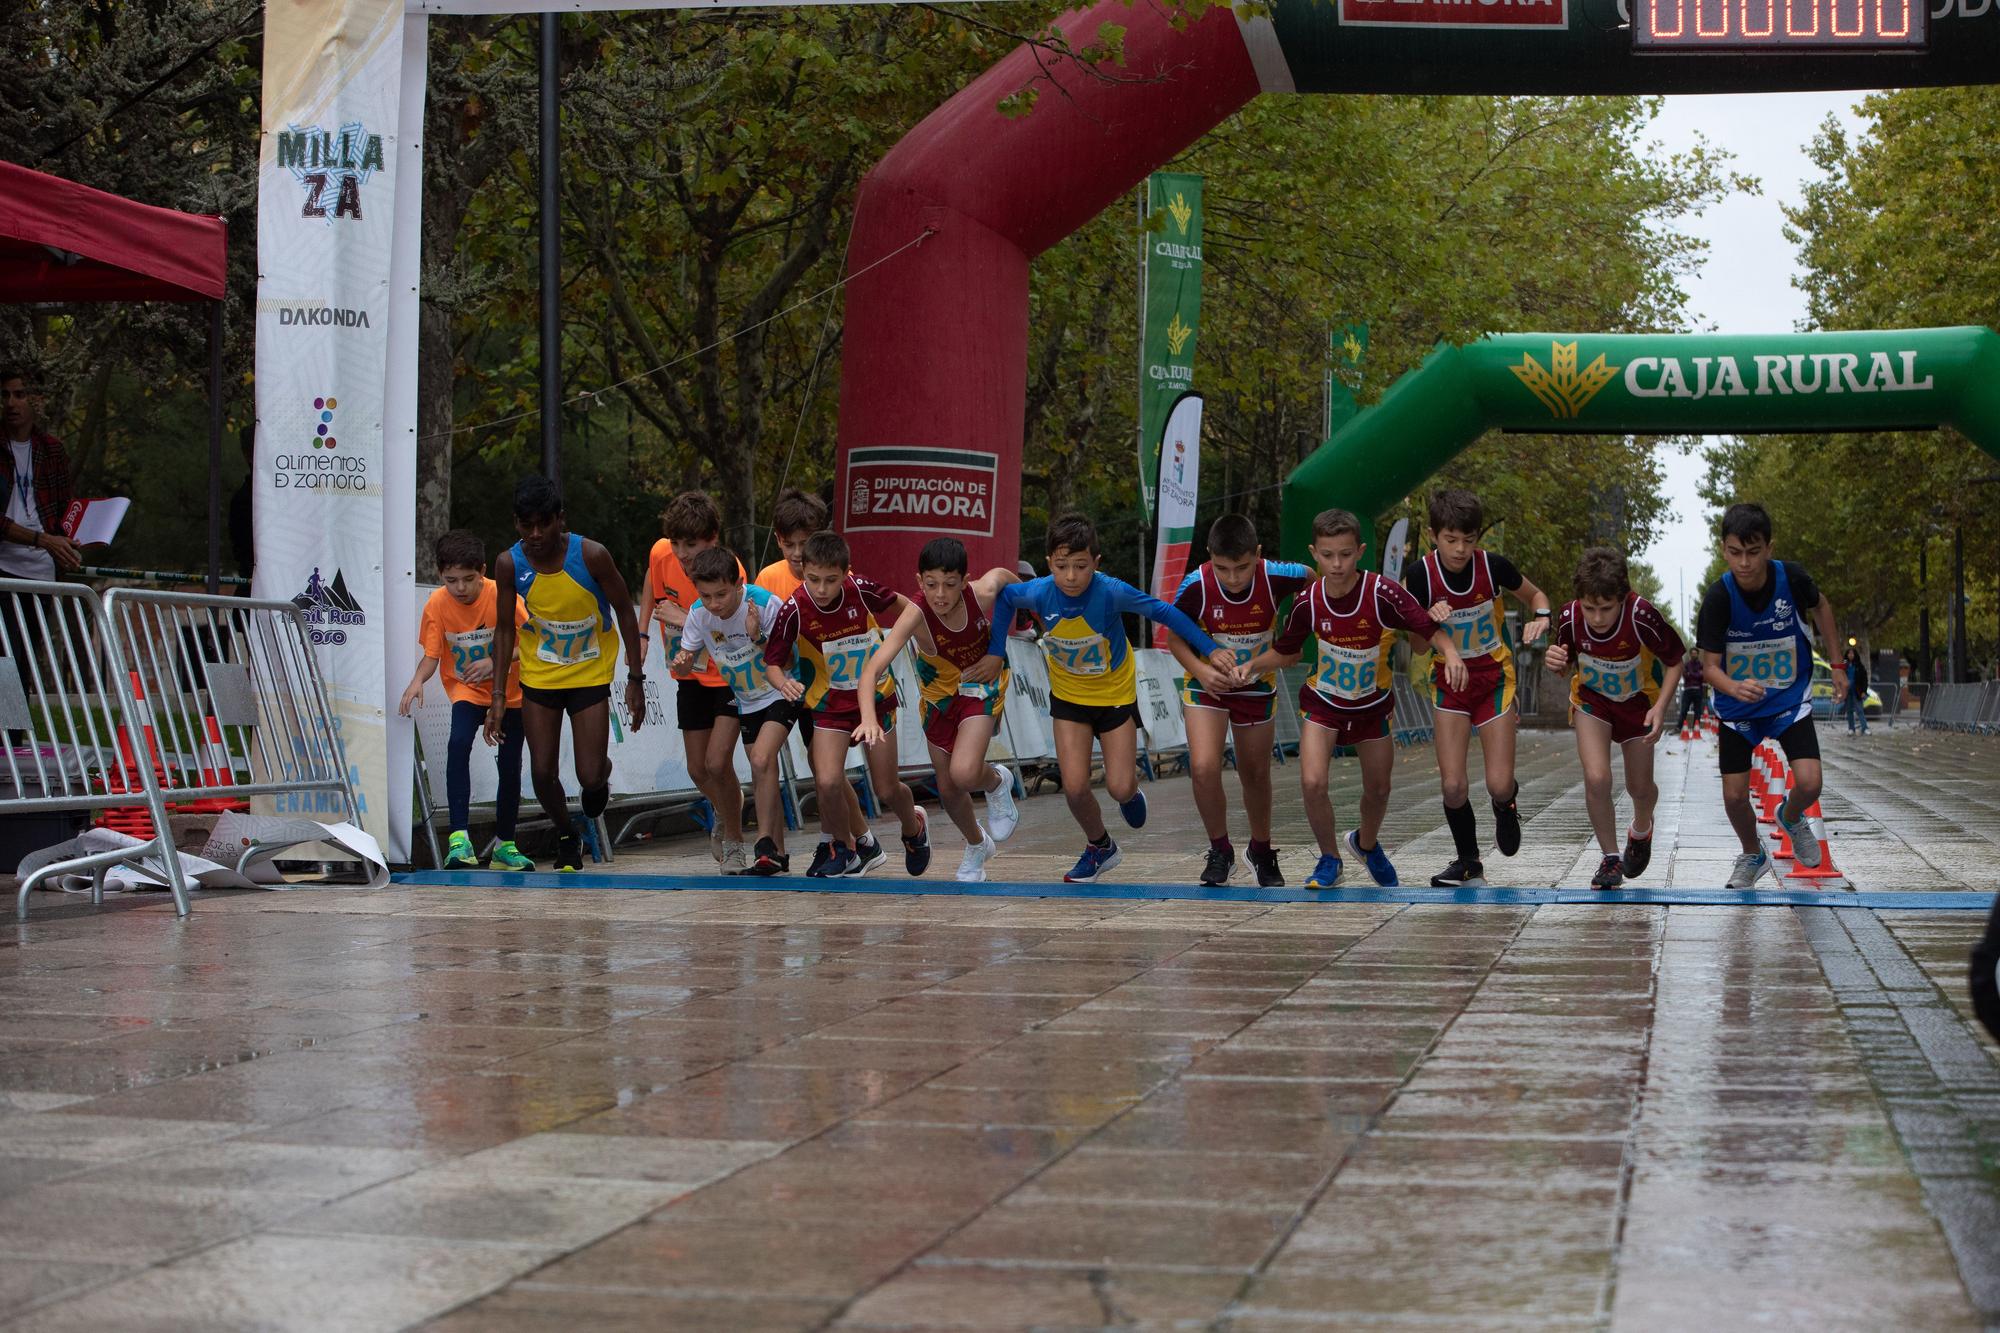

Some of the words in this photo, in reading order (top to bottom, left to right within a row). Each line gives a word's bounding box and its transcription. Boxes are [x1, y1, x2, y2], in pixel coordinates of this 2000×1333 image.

[277, 131, 385, 172] MILLA
[302, 173, 363, 220] ZA
[279, 307, 370, 328] DAKONDA
[1624, 355, 1750, 400] CAJA
[1753, 350, 1934, 396] RURAL
[275, 455, 366, 472] alimentos
[294, 474, 366, 491] zamora
[874, 477, 965, 493] DIPUTACIÓN
[968, 482, 987, 496] DE
[872, 493, 987, 519] ZAMORA
[328, 606, 365, 625] Run
[302, 626, 347, 646] oro
[540, 627, 593, 658] 277
[828, 643, 880, 683] 27
[1320, 655, 1376, 692] 286
[1730, 650, 1793, 681] 268
[1583, 666, 1638, 696] 281
